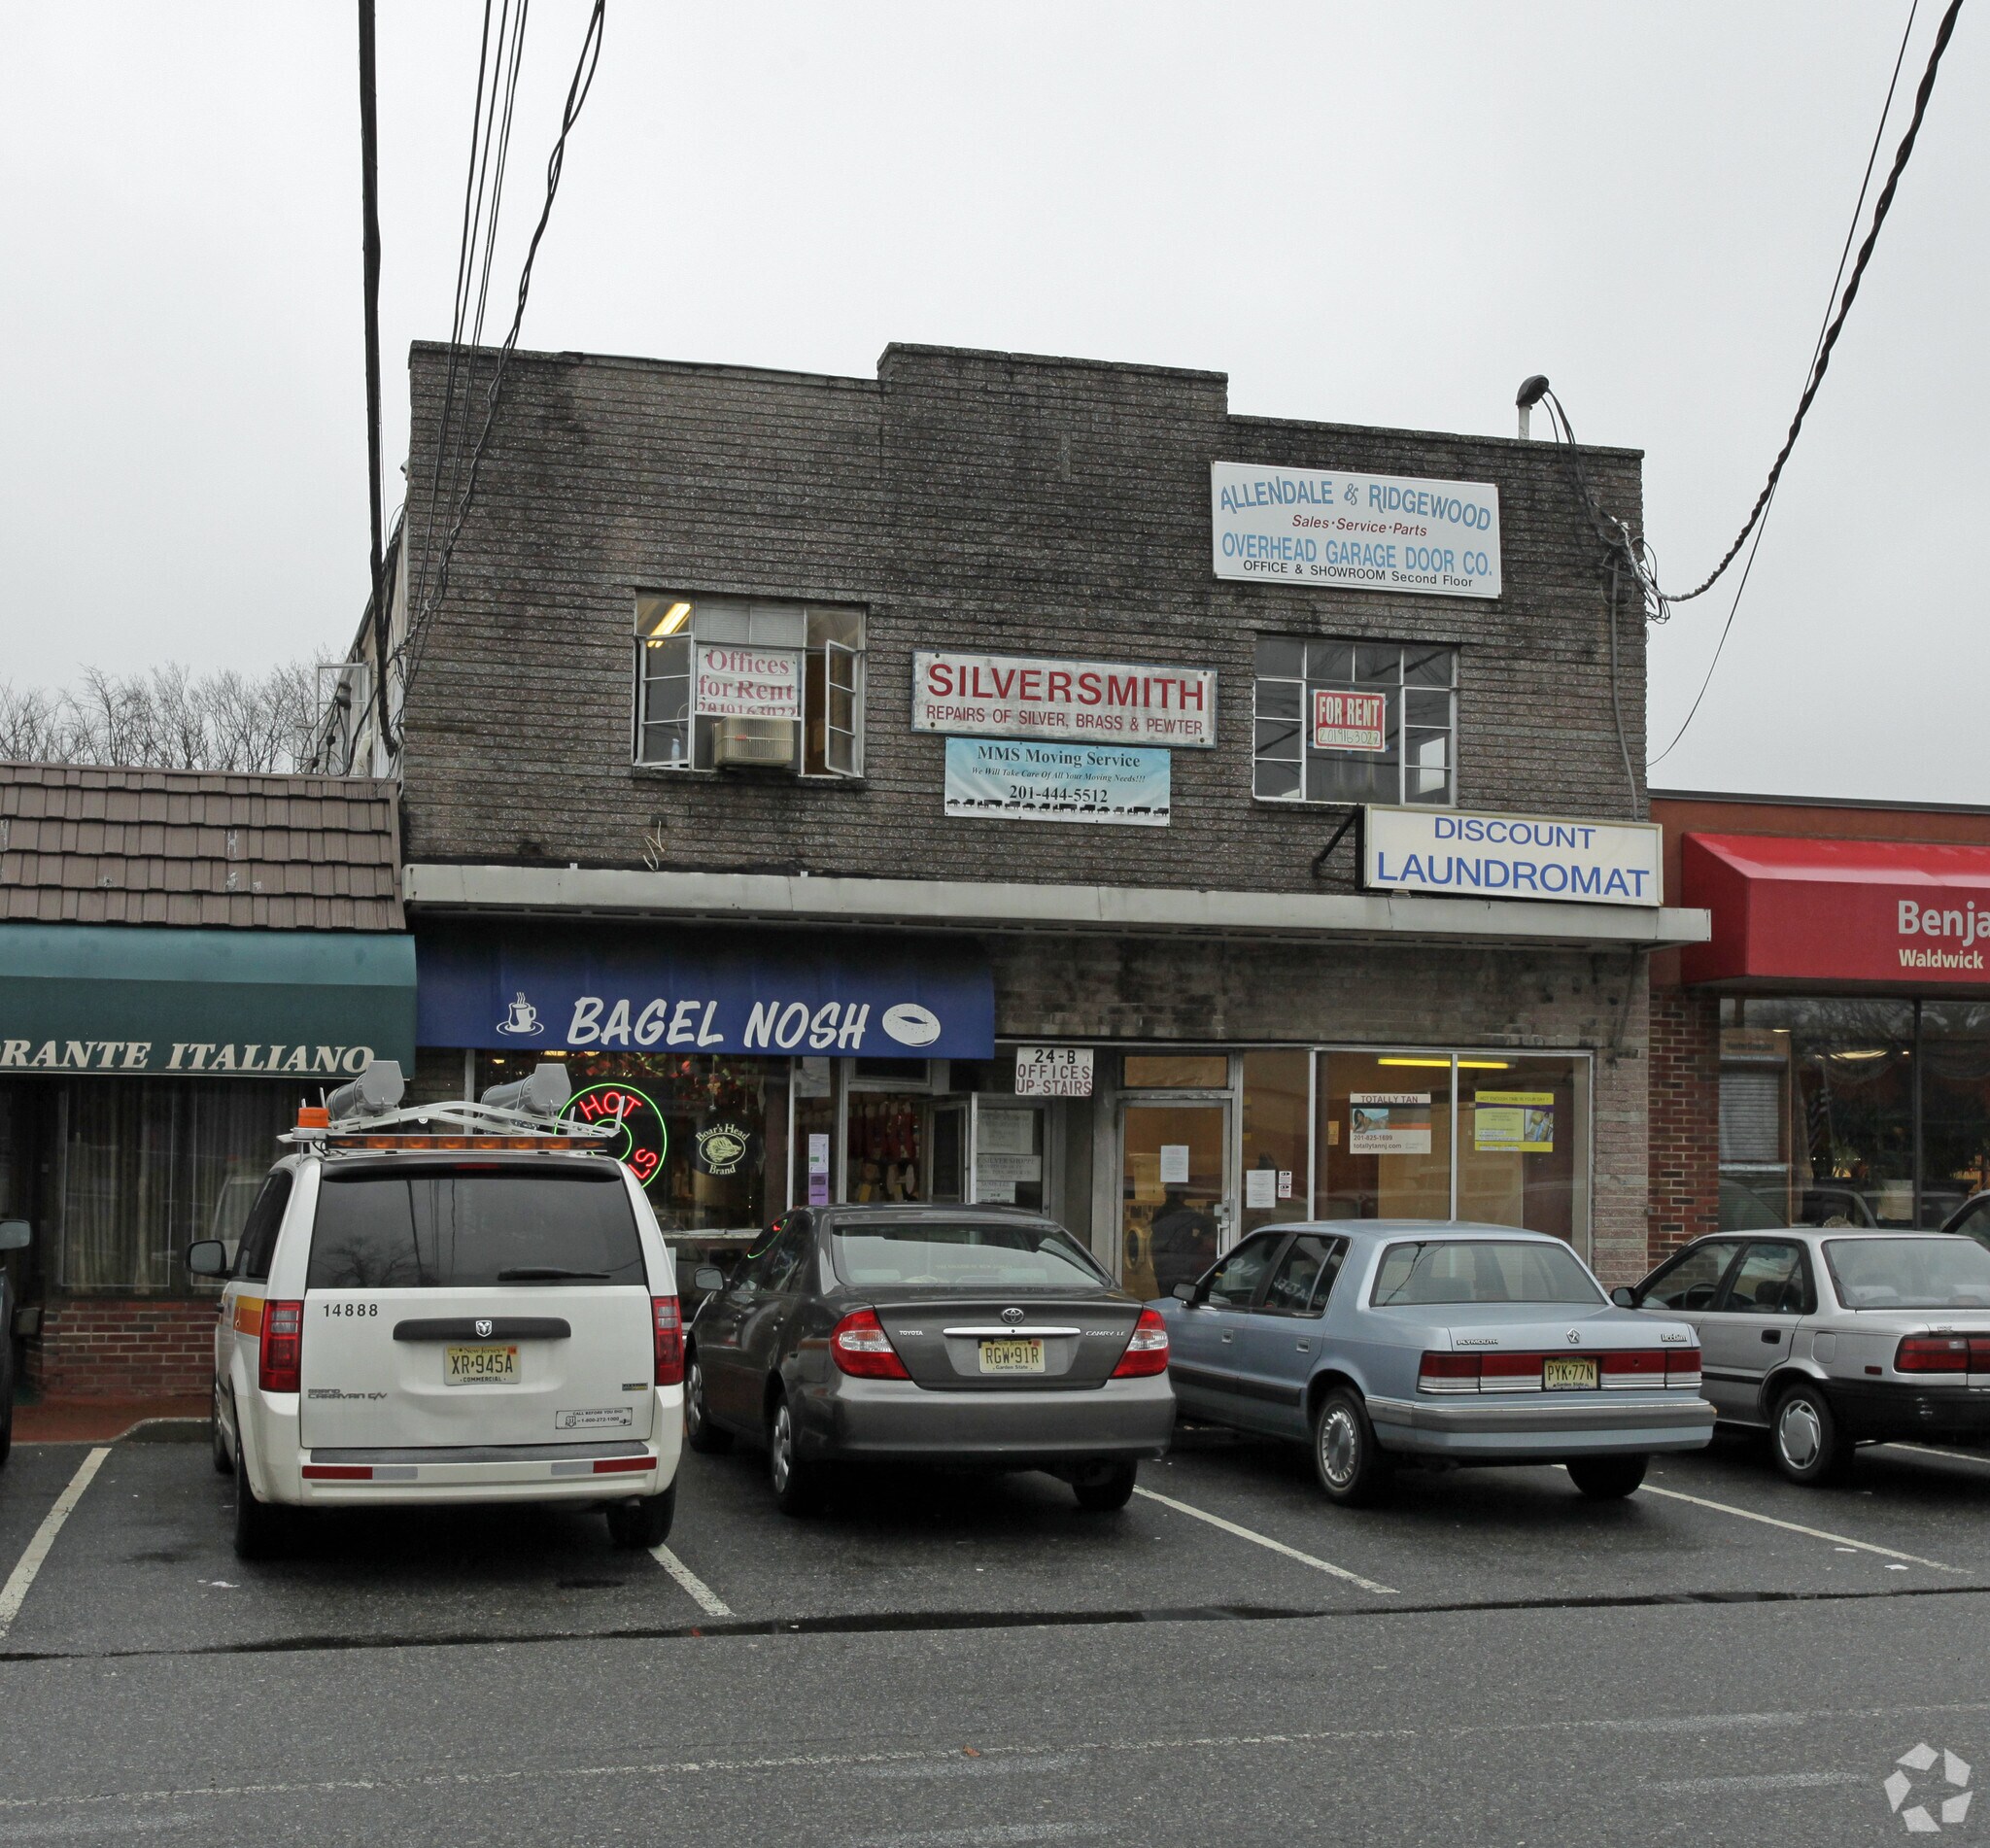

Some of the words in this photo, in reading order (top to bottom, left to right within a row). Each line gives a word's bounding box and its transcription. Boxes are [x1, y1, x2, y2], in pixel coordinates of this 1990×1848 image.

[1221, 476, 1333, 514] ALLENDALE
[1344, 483, 1358, 505] &
[1369, 484, 1491, 530] RIDGEWOOD
[1221, 531, 1317, 563] OVERHEAD
[1326, 539, 1396, 568] GARAGE
[1405, 546, 1455, 572] DOOR
[1463, 551, 1492, 576] CO.
[1243, 560, 1288, 573] OFFICE
[1295, 564, 1303, 575] &
[1310, 565, 1386, 581] SHOWROOM
[1391, 570, 1437, 585] Second
[1444, 574, 1473, 587] Floor
[706, 650, 789, 674] Offices
[699, 675, 733, 697] for
[736, 680, 795, 701] Rent
[927, 663, 1204, 711] SILVERSMITH
[926, 705, 985, 723] REPAIRS
[993, 708, 1012, 724] OF
[1018, 710, 1069, 728] SILVER,
[1076, 713, 1123, 731] BRASS
[1130, 717, 1139, 731] &
[1147, 718, 1203, 735] PEWTER
[1319, 697, 1342, 724] FOR
[1347, 698, 1380, 727] RENT
[978, 745, 1020, 761] MMS
[1025, 748, 1082, 768] Moving
[1086, 751, 1141, 768] Service
[972, 767, 983, 775] We
[1002, 769, 1019, 777] Take
[1021, 770, 1040, 778] Care
[1041, 770, 1051, 779] Of
[1082, 773, 1112, 782] Moving
[1010, 785, 1108, 803] 201-444-5512
[1435, 817, 1595, 849] DISCOUNT
[1378, 851, 1650, 897] LAUNDROMAT
[1899, 948, 1983, 969] Waldwick
[566, 996, 724, 1047] BAGEL
[743, 1001, 871, 1049] NOSH
[0, 1040, 152, 1069] RANTE
[165, 1043, 375, 1074] ITALIANO
[1035, 1048, 1076, 1064] 24-B
[1017, 1063, 1090, 1079] OFFICES
[1016, 1078, 1092, 1095] UP-STAIRS
[1360, 1095, 1398, 1104] TOTALLY
[579, 1091, 642, 1120] HOT
[695, 1123, 723, 1142] Boar's
[724, 1123, 750, 1141] Head
[628, 1147, 660, 1180] LS
[709, 1164, 736, 1175] Brand
[323, 1303, 379, 1318] 14888
